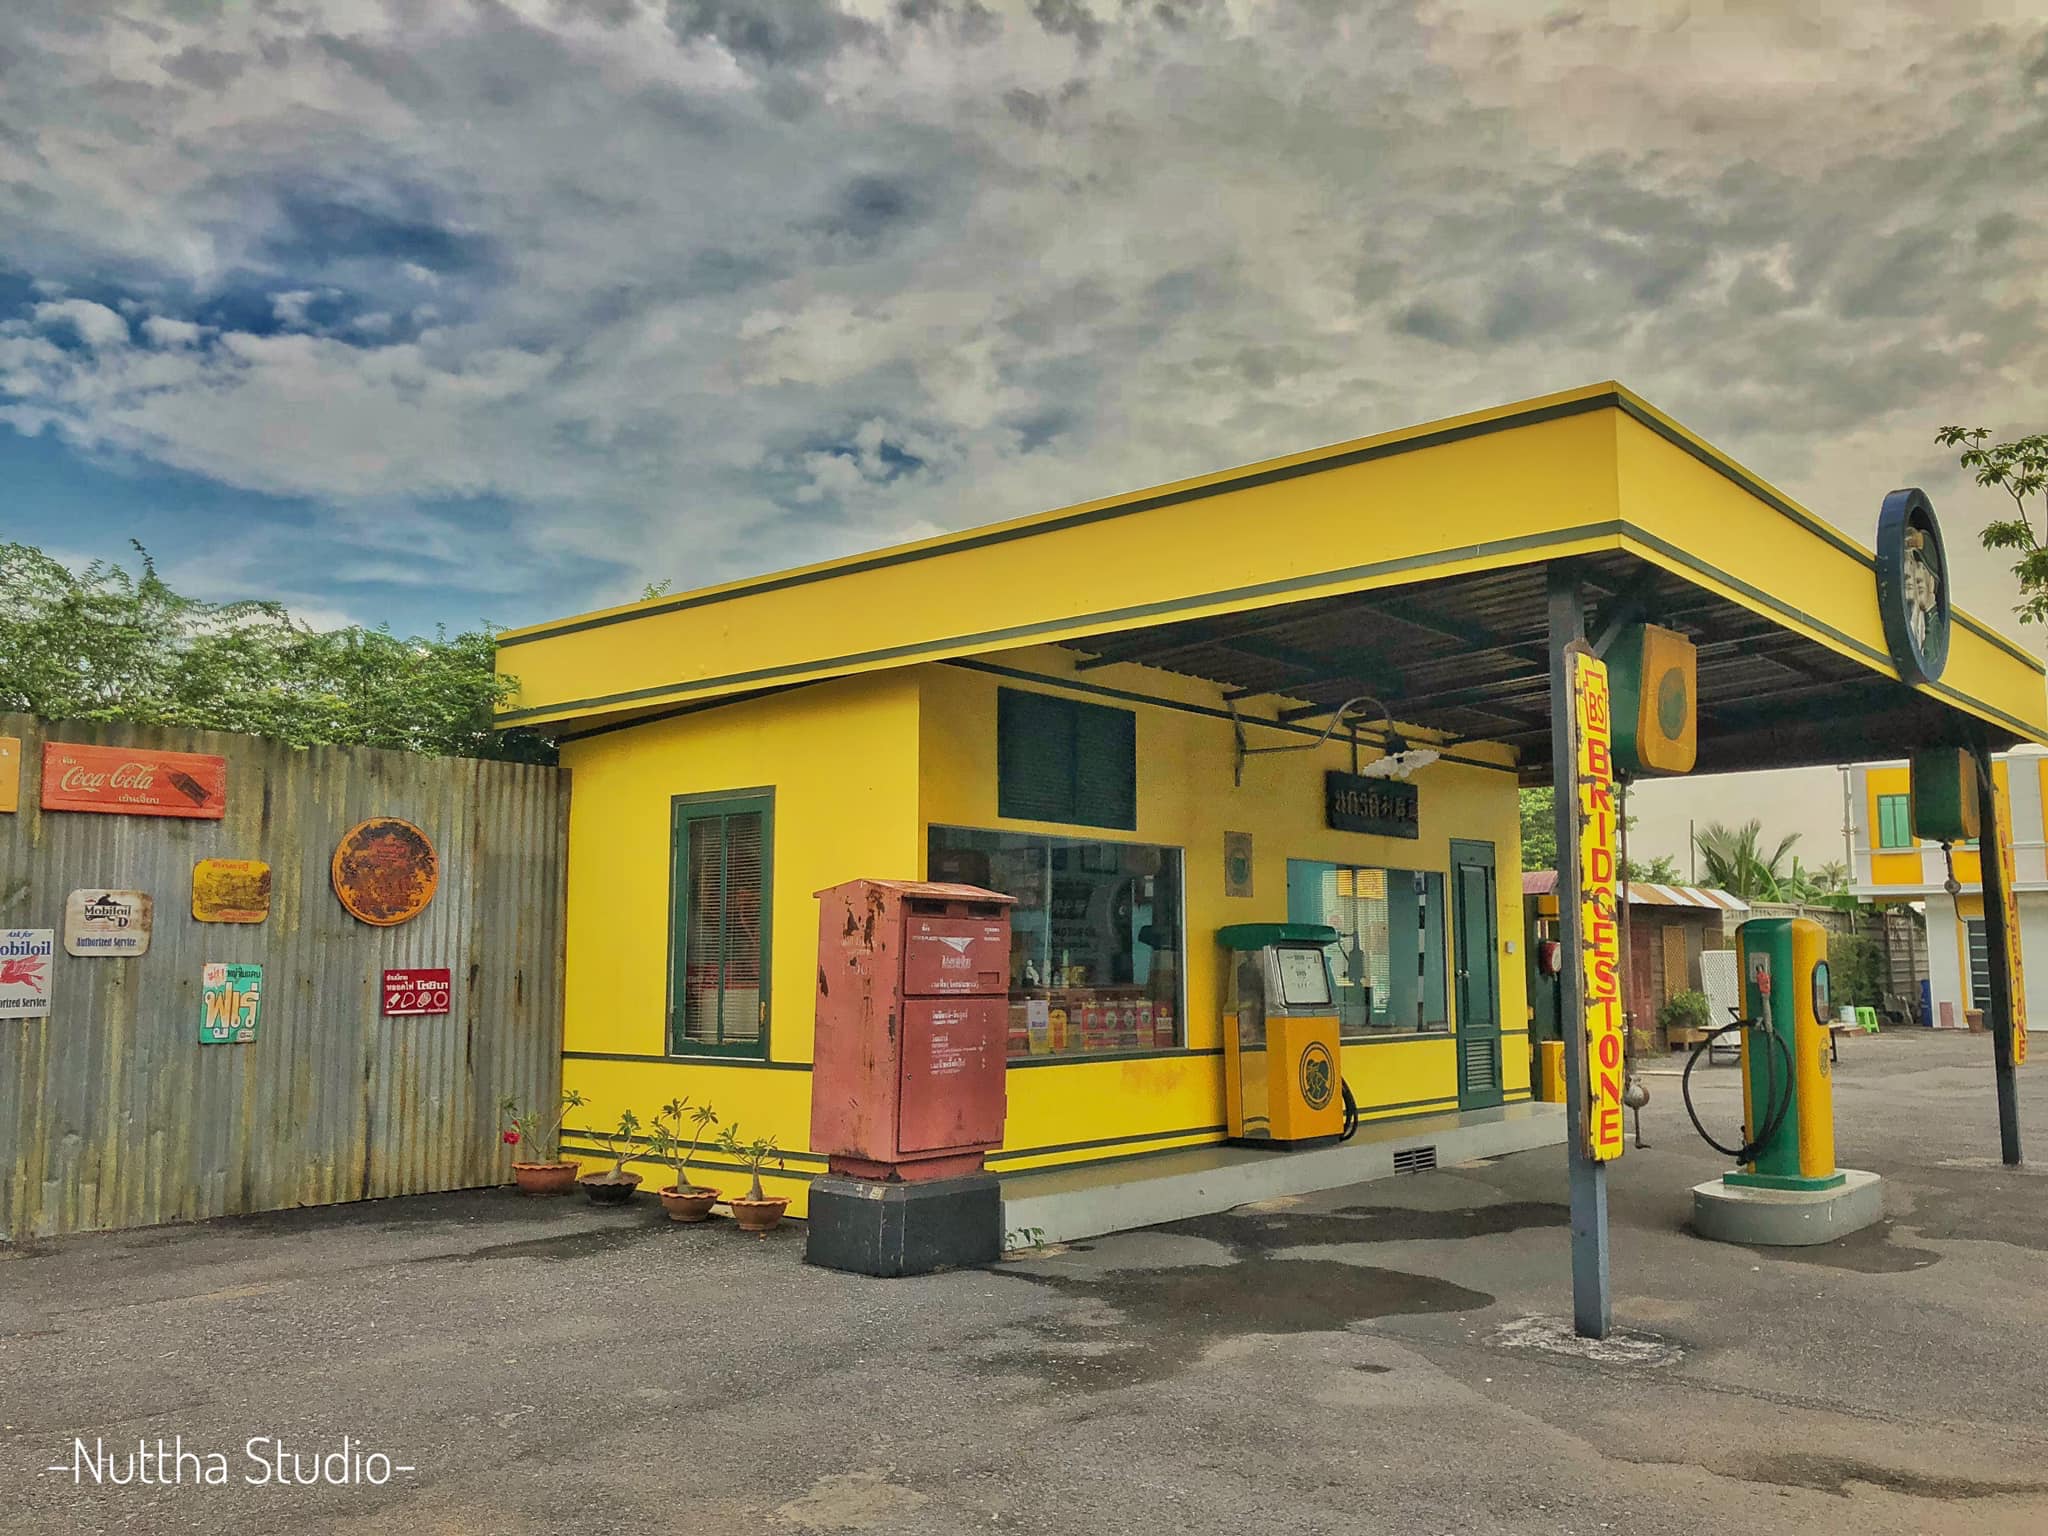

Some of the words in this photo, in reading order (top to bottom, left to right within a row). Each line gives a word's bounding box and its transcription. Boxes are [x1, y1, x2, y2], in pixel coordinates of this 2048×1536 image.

[1589, 691, 1605, 728] BS
[84, 904, 131, 916] Mobiloil
[0, 941, 51, 956] obiloil
[1588, 738, 1621, 1145] BRIDGESTONE
